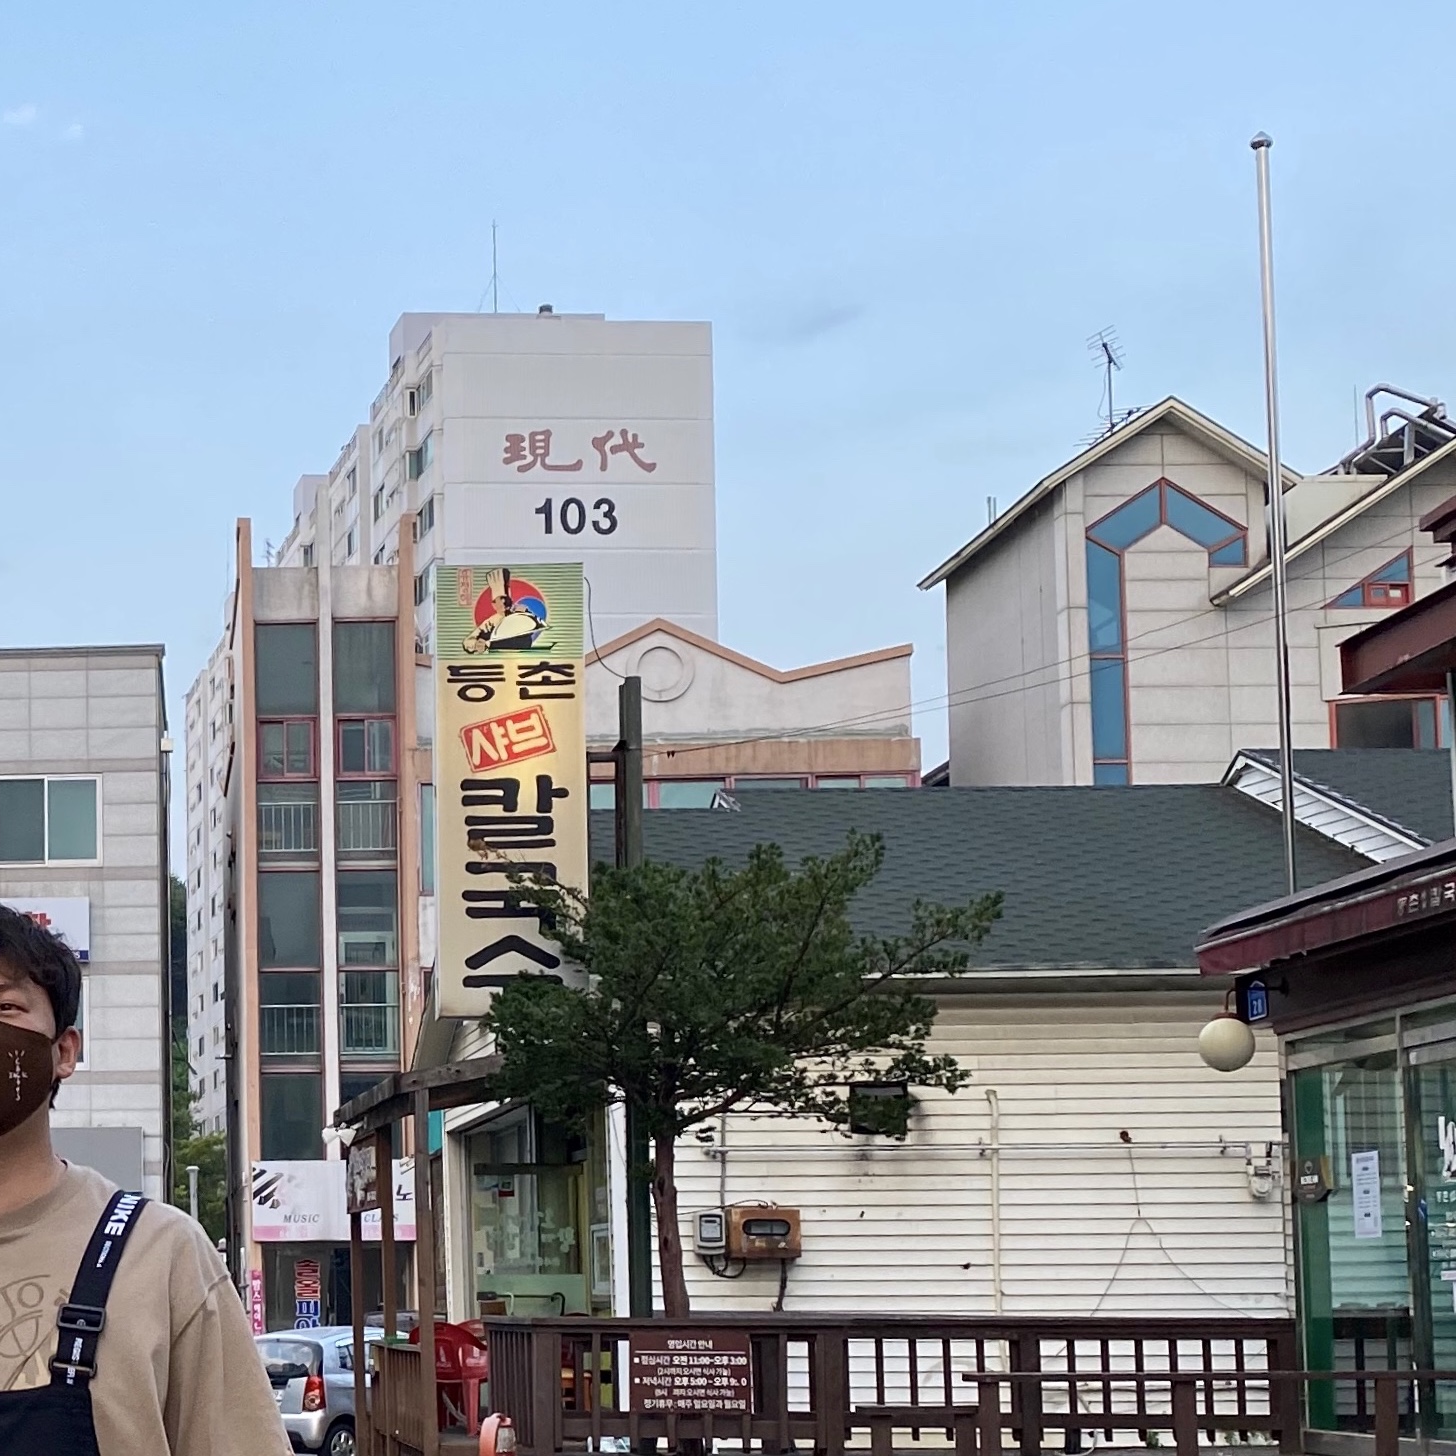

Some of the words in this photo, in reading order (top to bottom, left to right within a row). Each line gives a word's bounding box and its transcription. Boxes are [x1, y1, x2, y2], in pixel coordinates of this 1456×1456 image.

[503, 428, 657, 473] 現代
[535, 497, 618, 535] 103
[447, 661, 576, 702] 등촌
[471, 712, 548, 766] 샤브
[104, 1194, 141, 1236] NIKE
[283, 1213, 320, 1223] MUSIC
